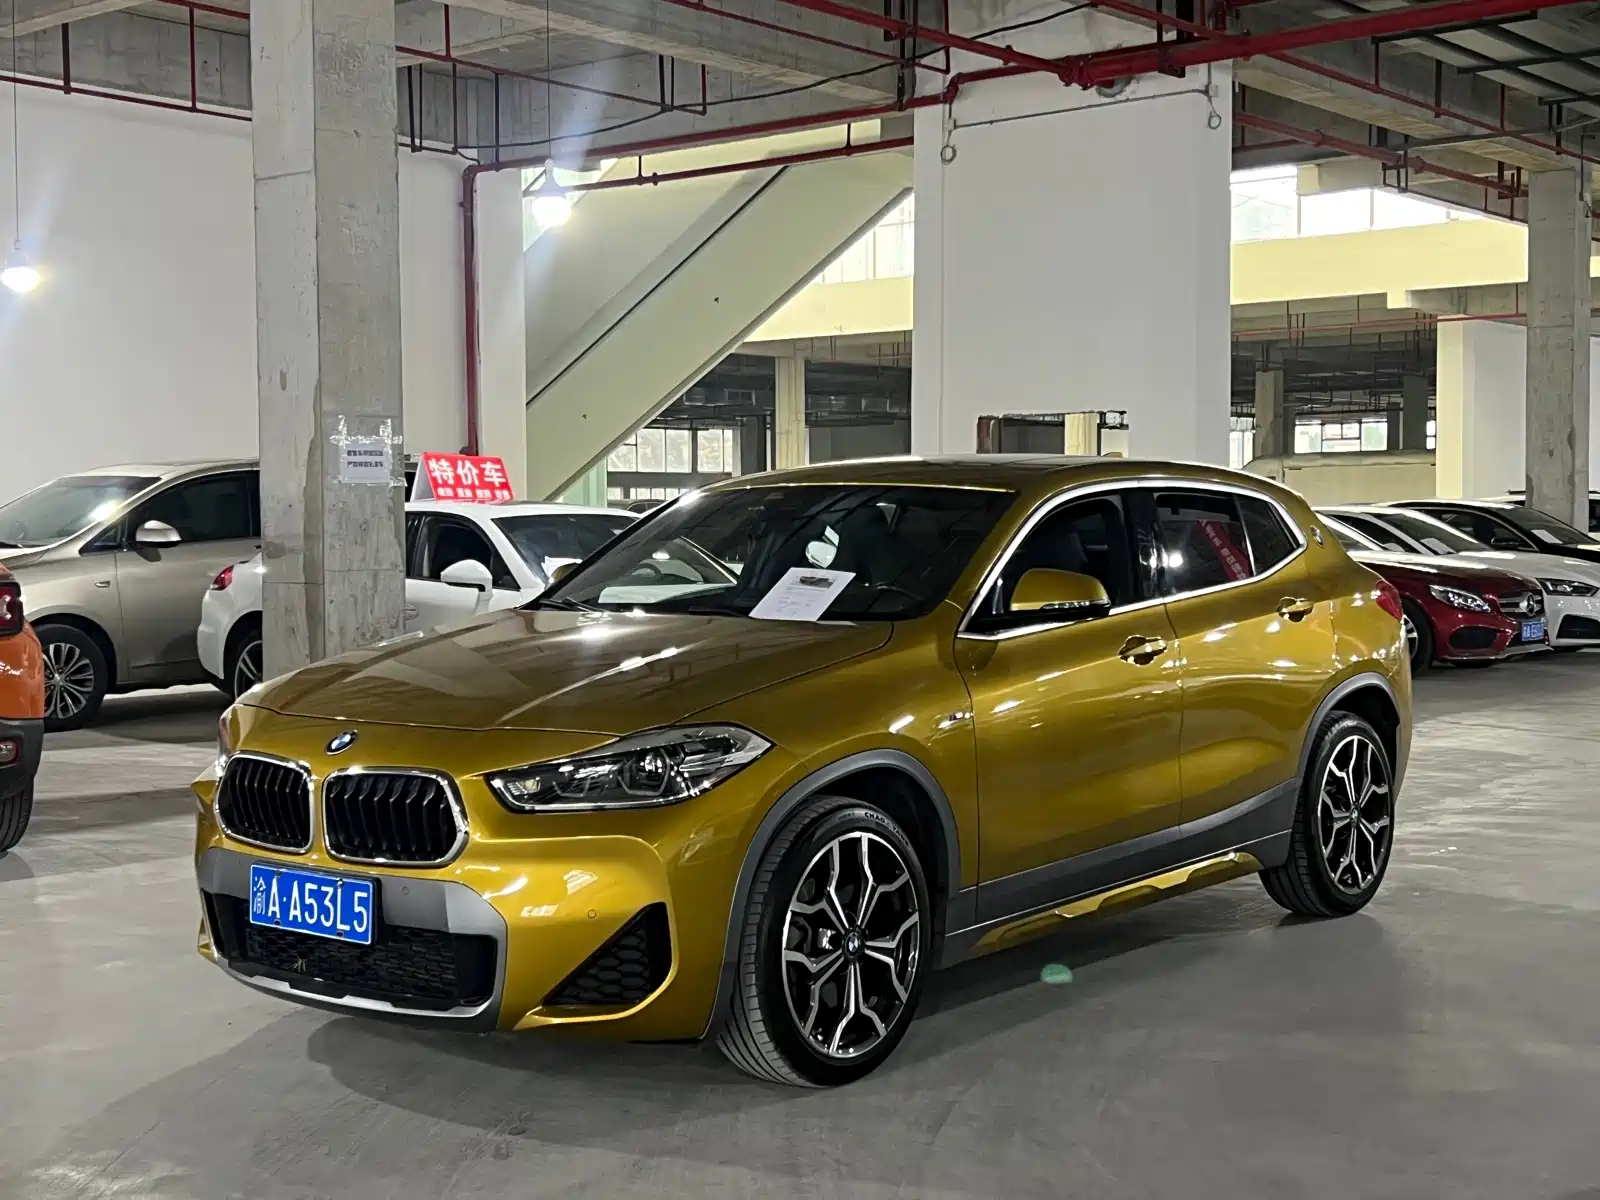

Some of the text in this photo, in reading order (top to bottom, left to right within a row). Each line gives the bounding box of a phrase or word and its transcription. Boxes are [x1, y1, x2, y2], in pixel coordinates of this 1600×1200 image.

[428, 458, 506, 487] 特价车
[864, 812, 885, 823] CHAO
